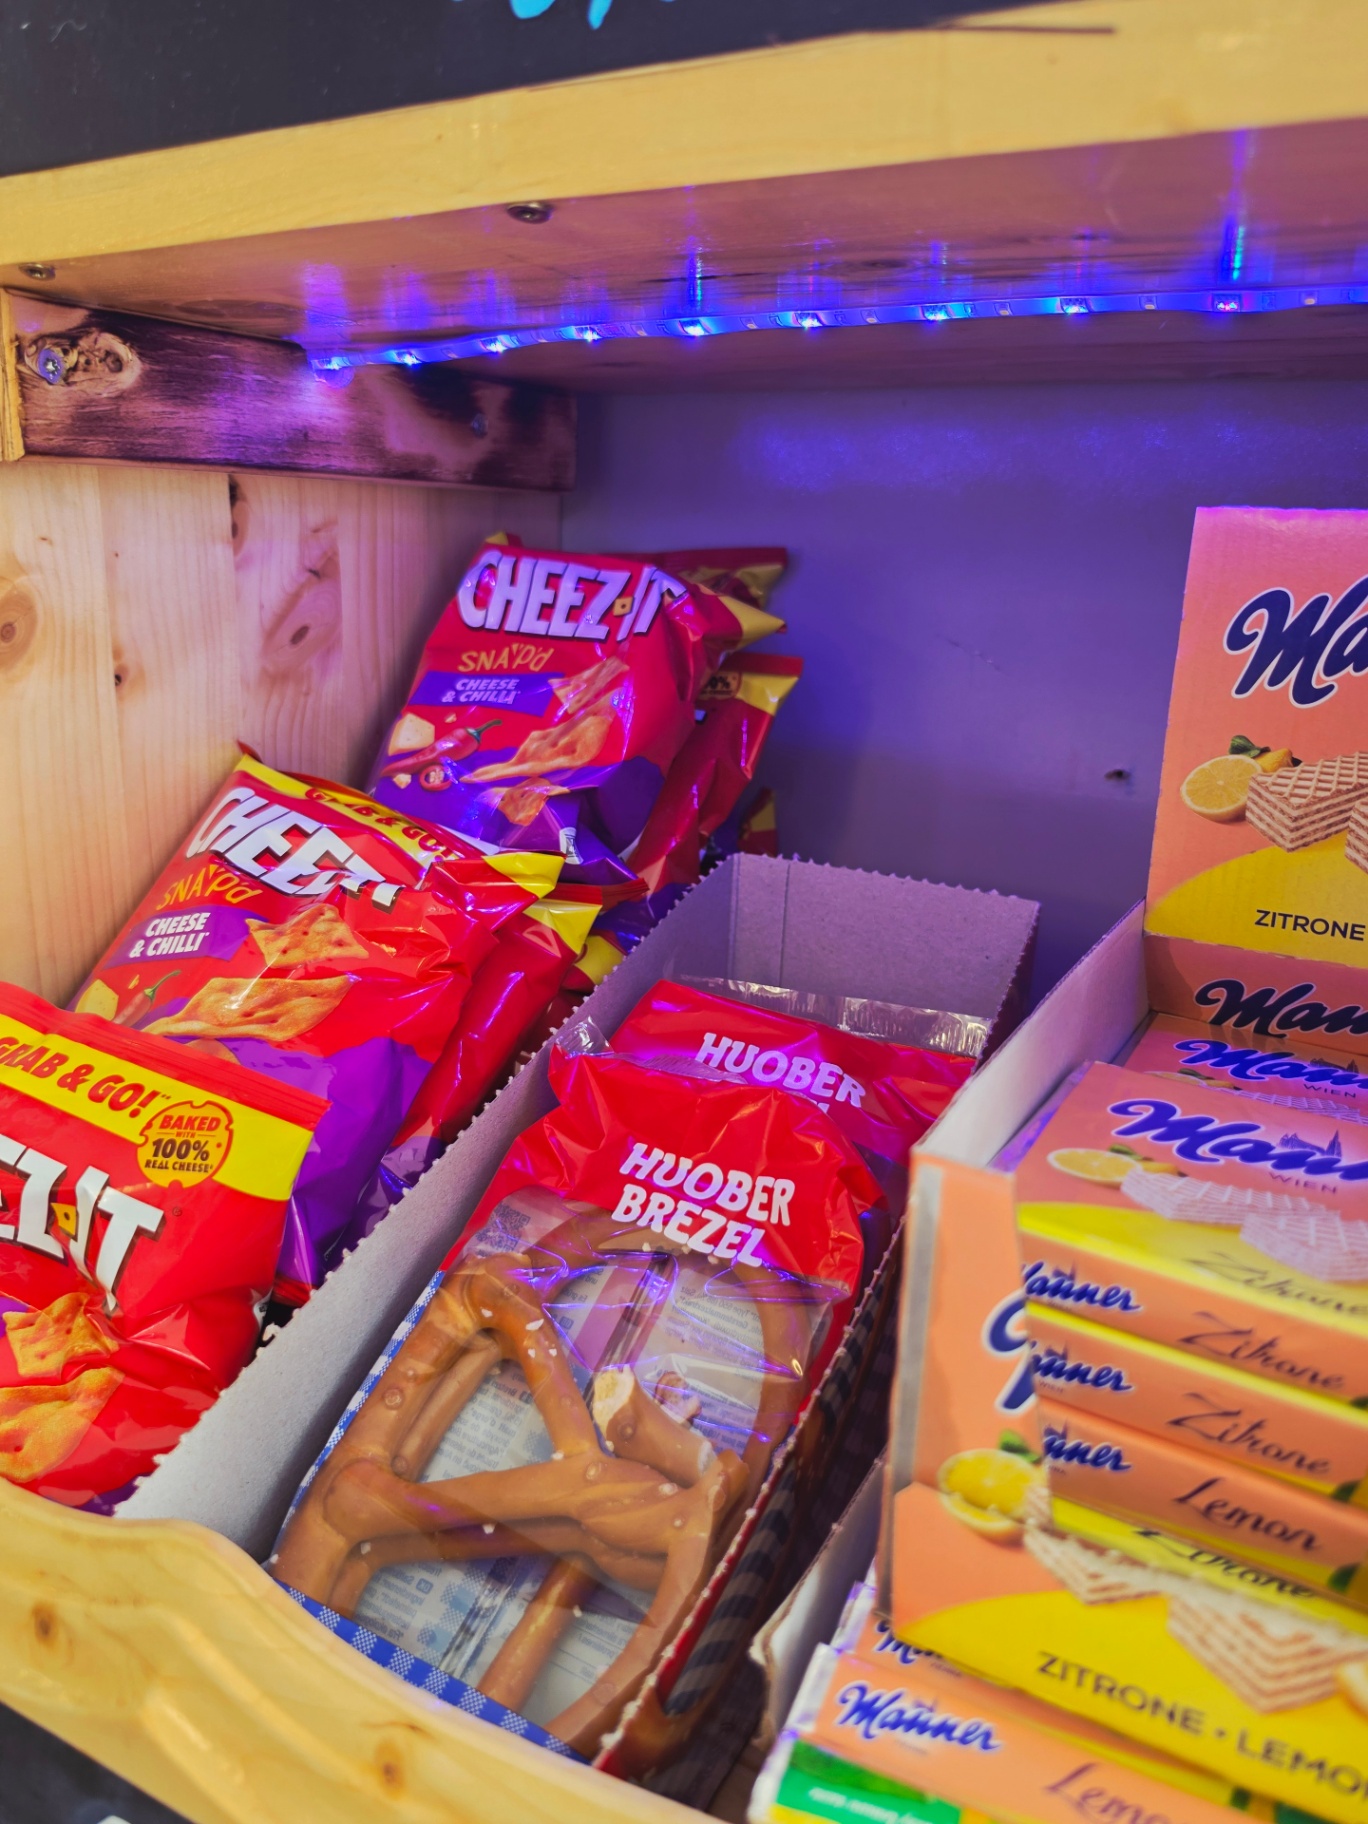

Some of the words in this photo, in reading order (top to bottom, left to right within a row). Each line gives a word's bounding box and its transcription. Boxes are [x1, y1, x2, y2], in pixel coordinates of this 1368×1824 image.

[441, 690, 457, 703] &
[455, 678, 521, 691] CHEESE
[144, 912, 212, 938] CHEESE
[1254, 909, 1367, 942] ZITRONE
[127, 938, 147, 959] &
[56, 1063, 96, 1093] &
[694, 1031, 867, 1108] HUOBER
[1303, 1083, 1357, 1099] WIEN
[158, 1114, 222, 1132] BAKED
[175, 1131, 197, 1139] WITH
[152, 1137, 210, 1162] 100%
[144, 1159, 170, 1170] REAL
[617, 1141, 797, 1227] HUOBER
[1268, 1171, 1338, 1195] WIEN
[611, 1183, 768, 1268] BREZEL
[1172, 1476, 1324, 1552] Lemon
[1037, 1649, 1208, 1737] ZITRONE
[836, 1682, 1001, 1751] Manner
